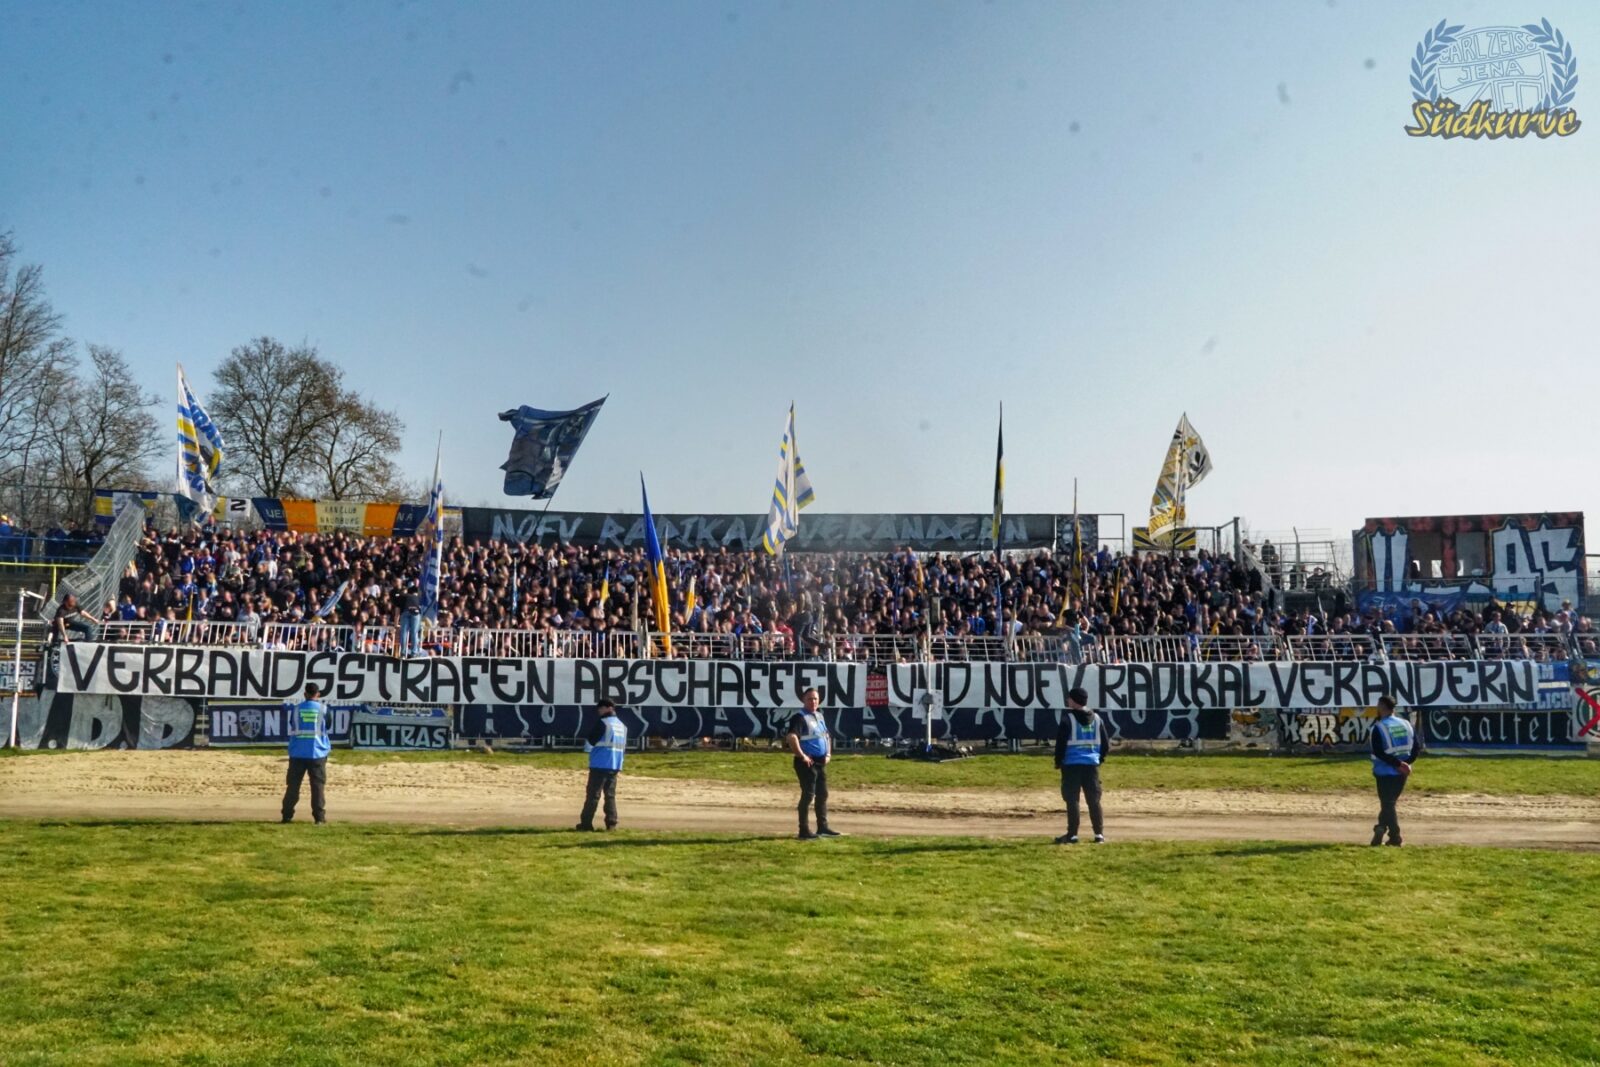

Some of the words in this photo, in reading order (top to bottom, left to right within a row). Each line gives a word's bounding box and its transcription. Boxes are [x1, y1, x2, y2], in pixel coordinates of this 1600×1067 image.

[492, 512, 583, 546] NOFV
[66, 645, 555, 704] VERBANDSSTRAFEN
[574, 658, 856, 707] ABSCHAFFEN
[984, 662, 1087, 708] NOFV
[1100, 662, 1267, 709] RADIKAL
[355, 724, 448, 748] ULTRAS
